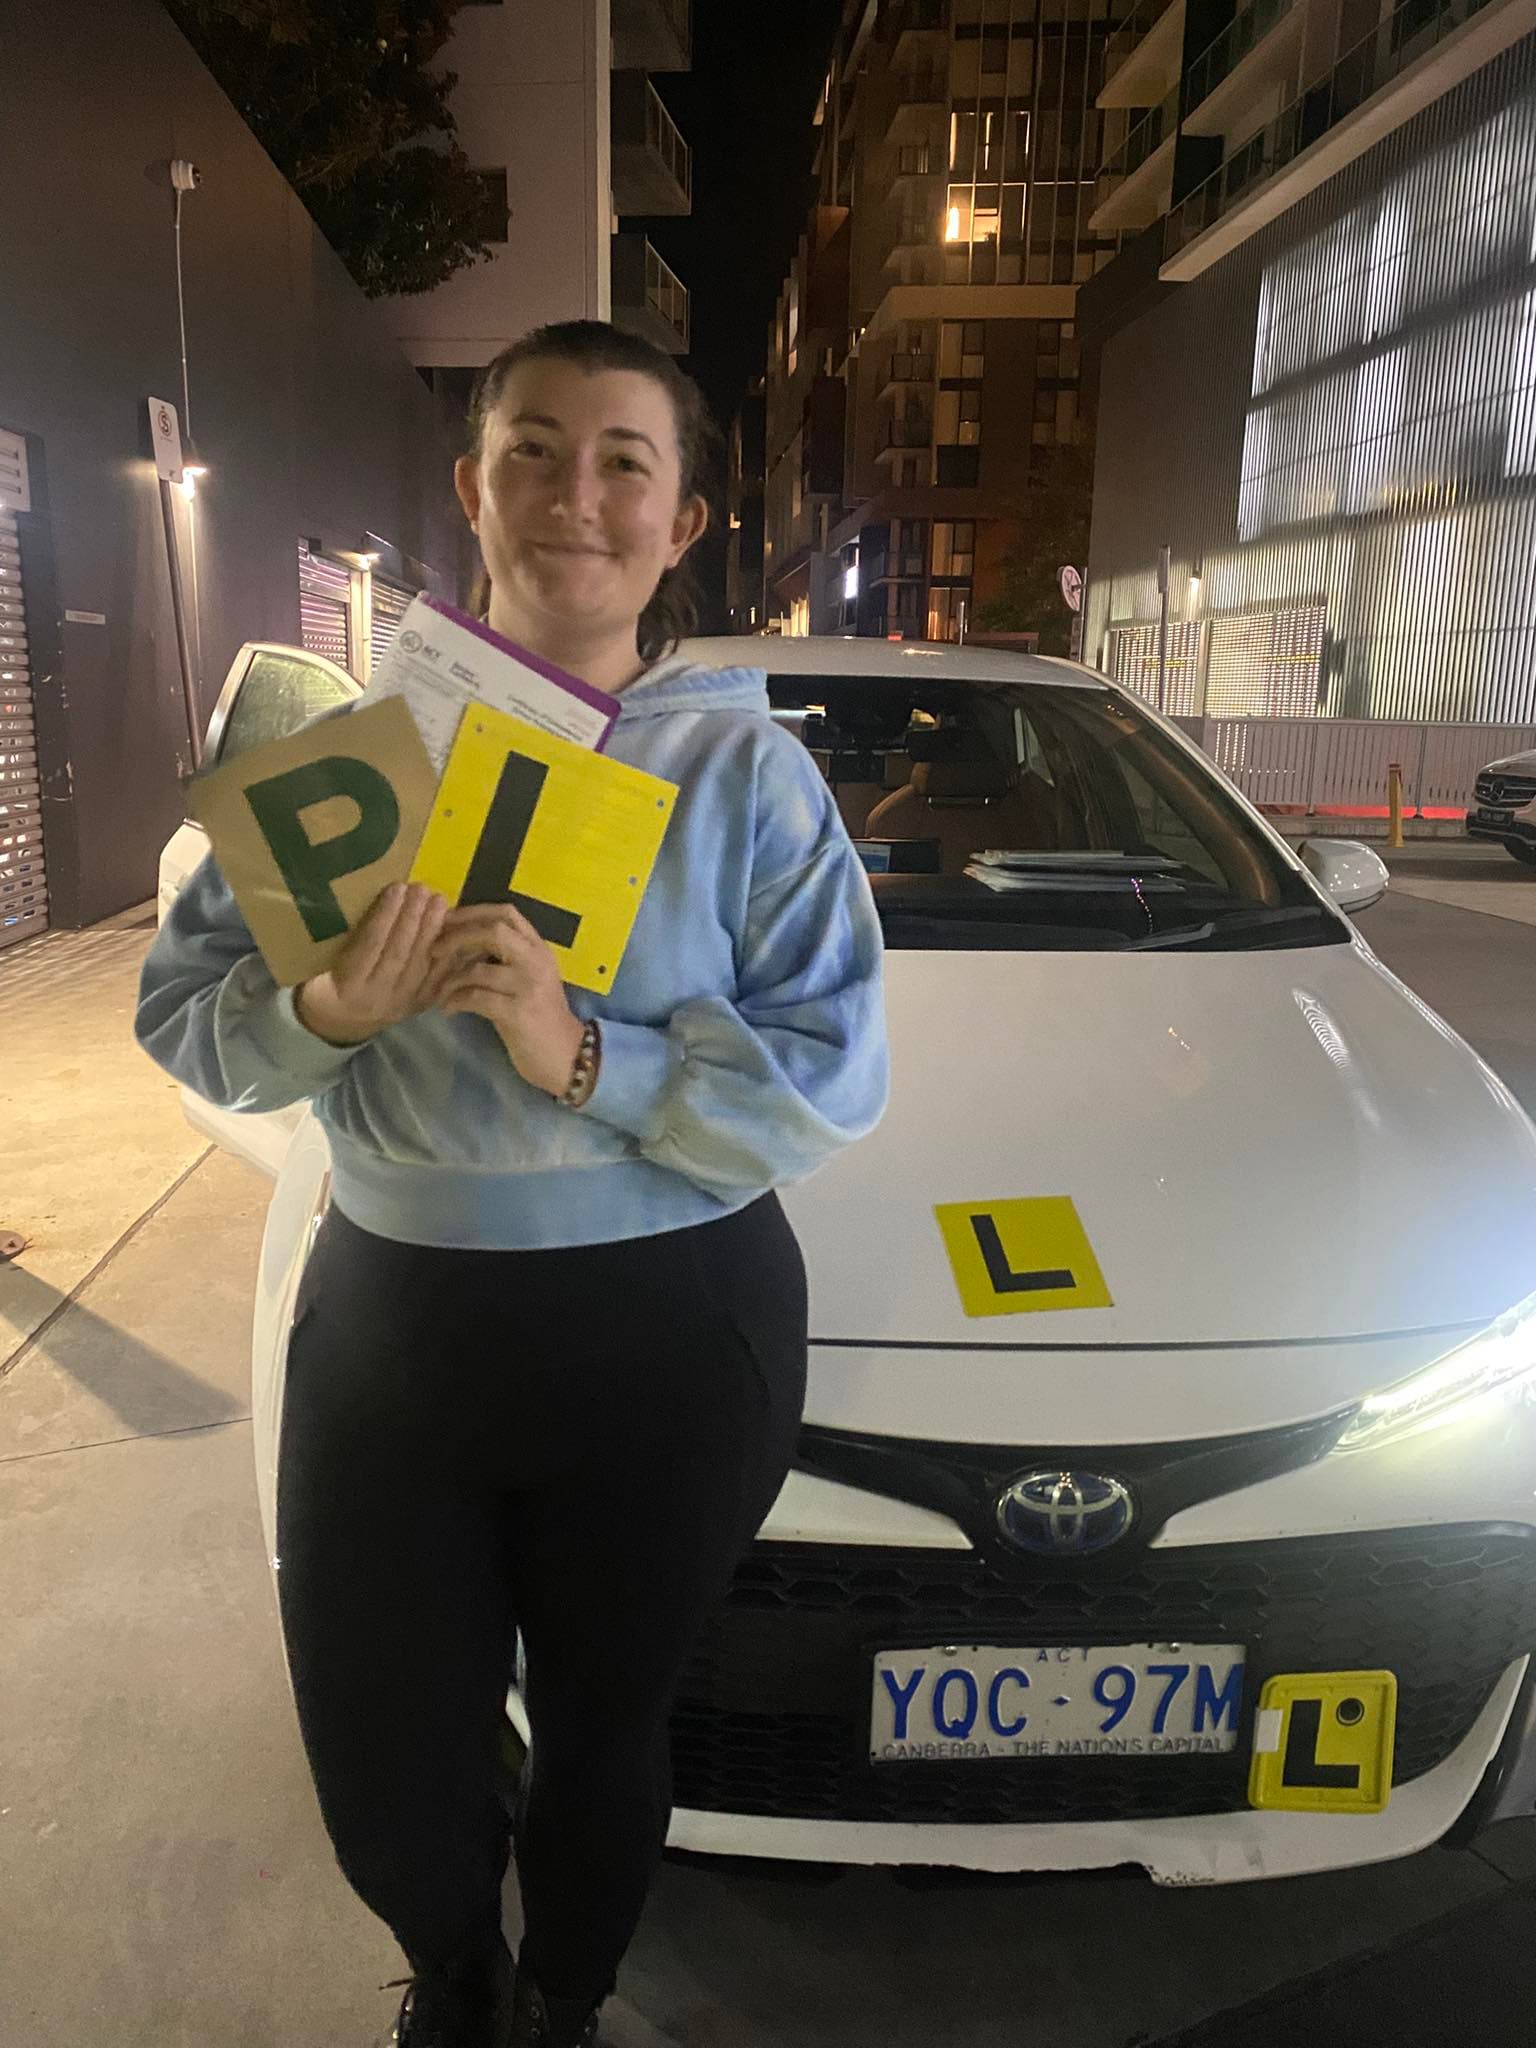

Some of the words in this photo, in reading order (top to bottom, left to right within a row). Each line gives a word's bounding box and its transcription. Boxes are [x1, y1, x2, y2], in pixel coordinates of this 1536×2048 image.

[243, 756, 399, 943] P
[458, 750, 583, 949] L
[969, 1214, 1077, 1293] L
[880, 1667, 1030, 1741] YQC
[1093, 1662, 1244, 1735] 97M
[882, 1741, 992, 1760] CANBERRA
[1013, 1740, 1050, 1756] THE
[1150, 1735, 1225, 1752] CAPITAL
[1282, 1699, 1361, 1789] L
